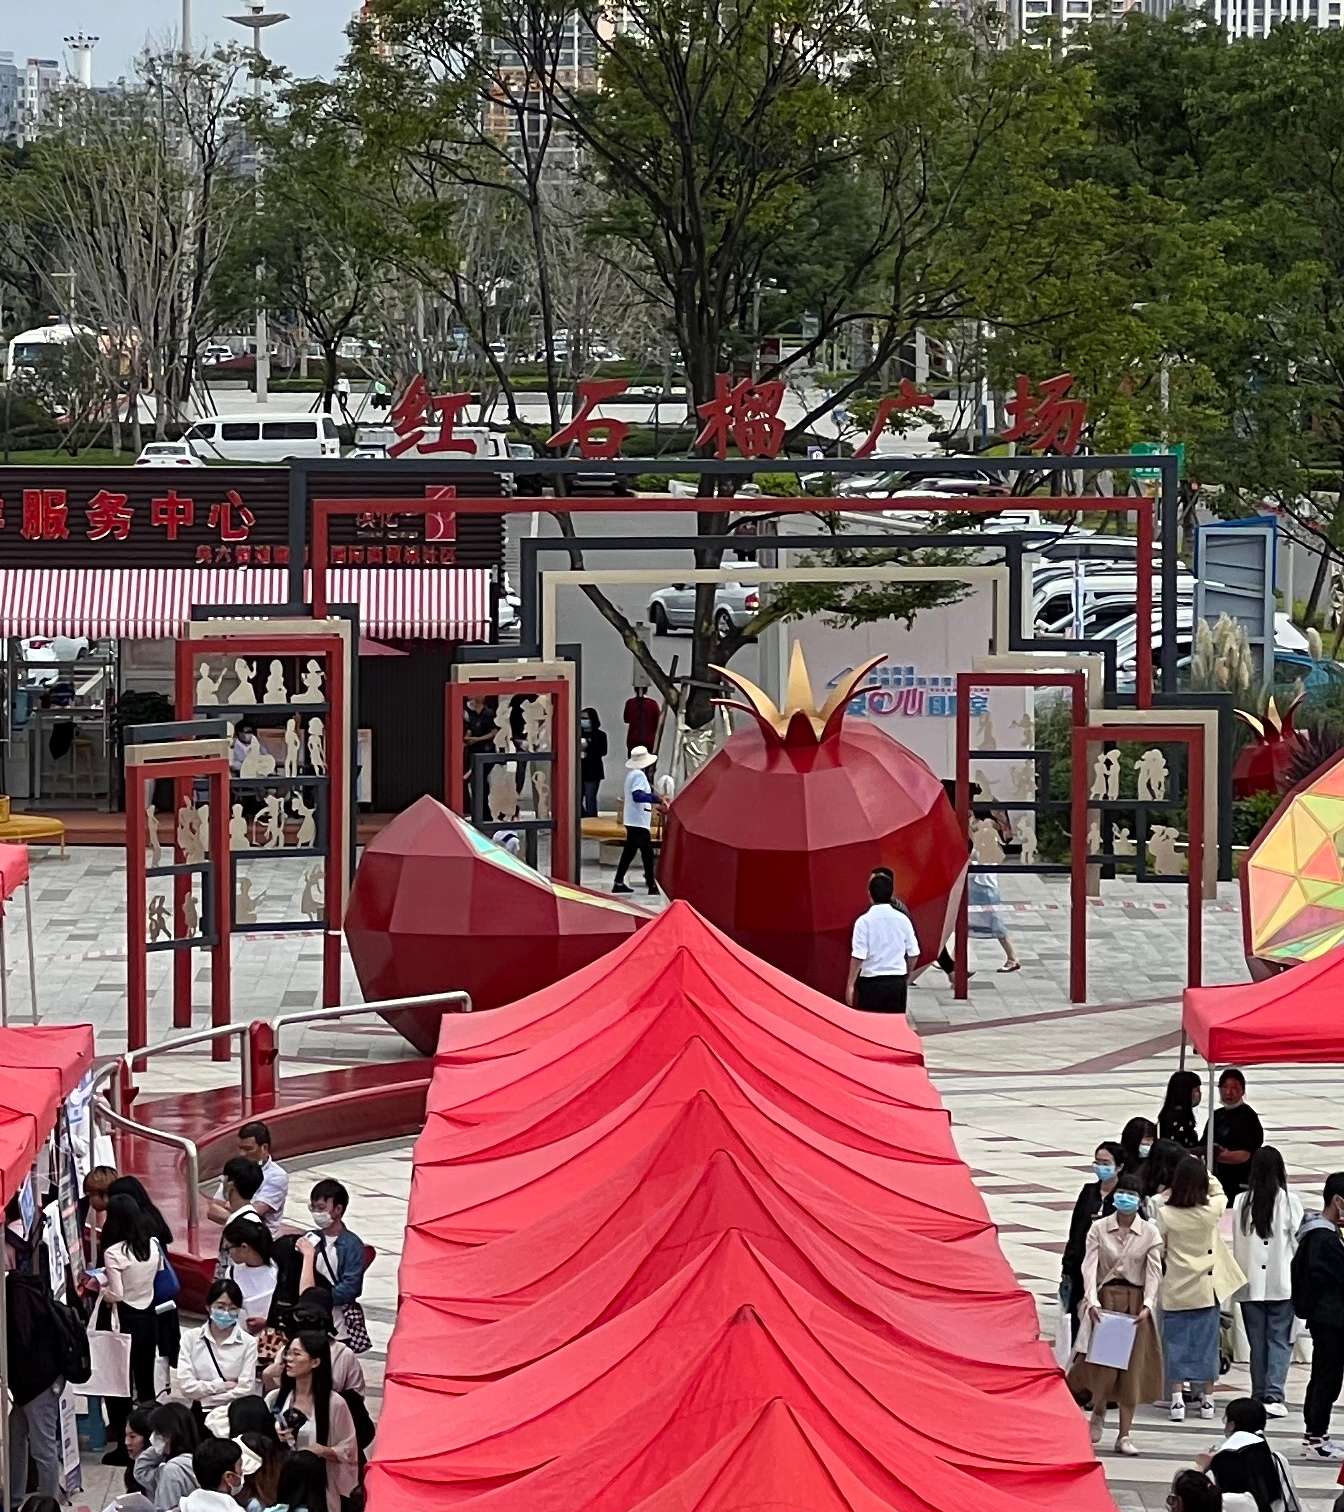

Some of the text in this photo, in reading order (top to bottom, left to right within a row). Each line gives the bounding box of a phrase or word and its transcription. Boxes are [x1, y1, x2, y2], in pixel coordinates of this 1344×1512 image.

[387, 372, 1089, 461] 红石榴广场
